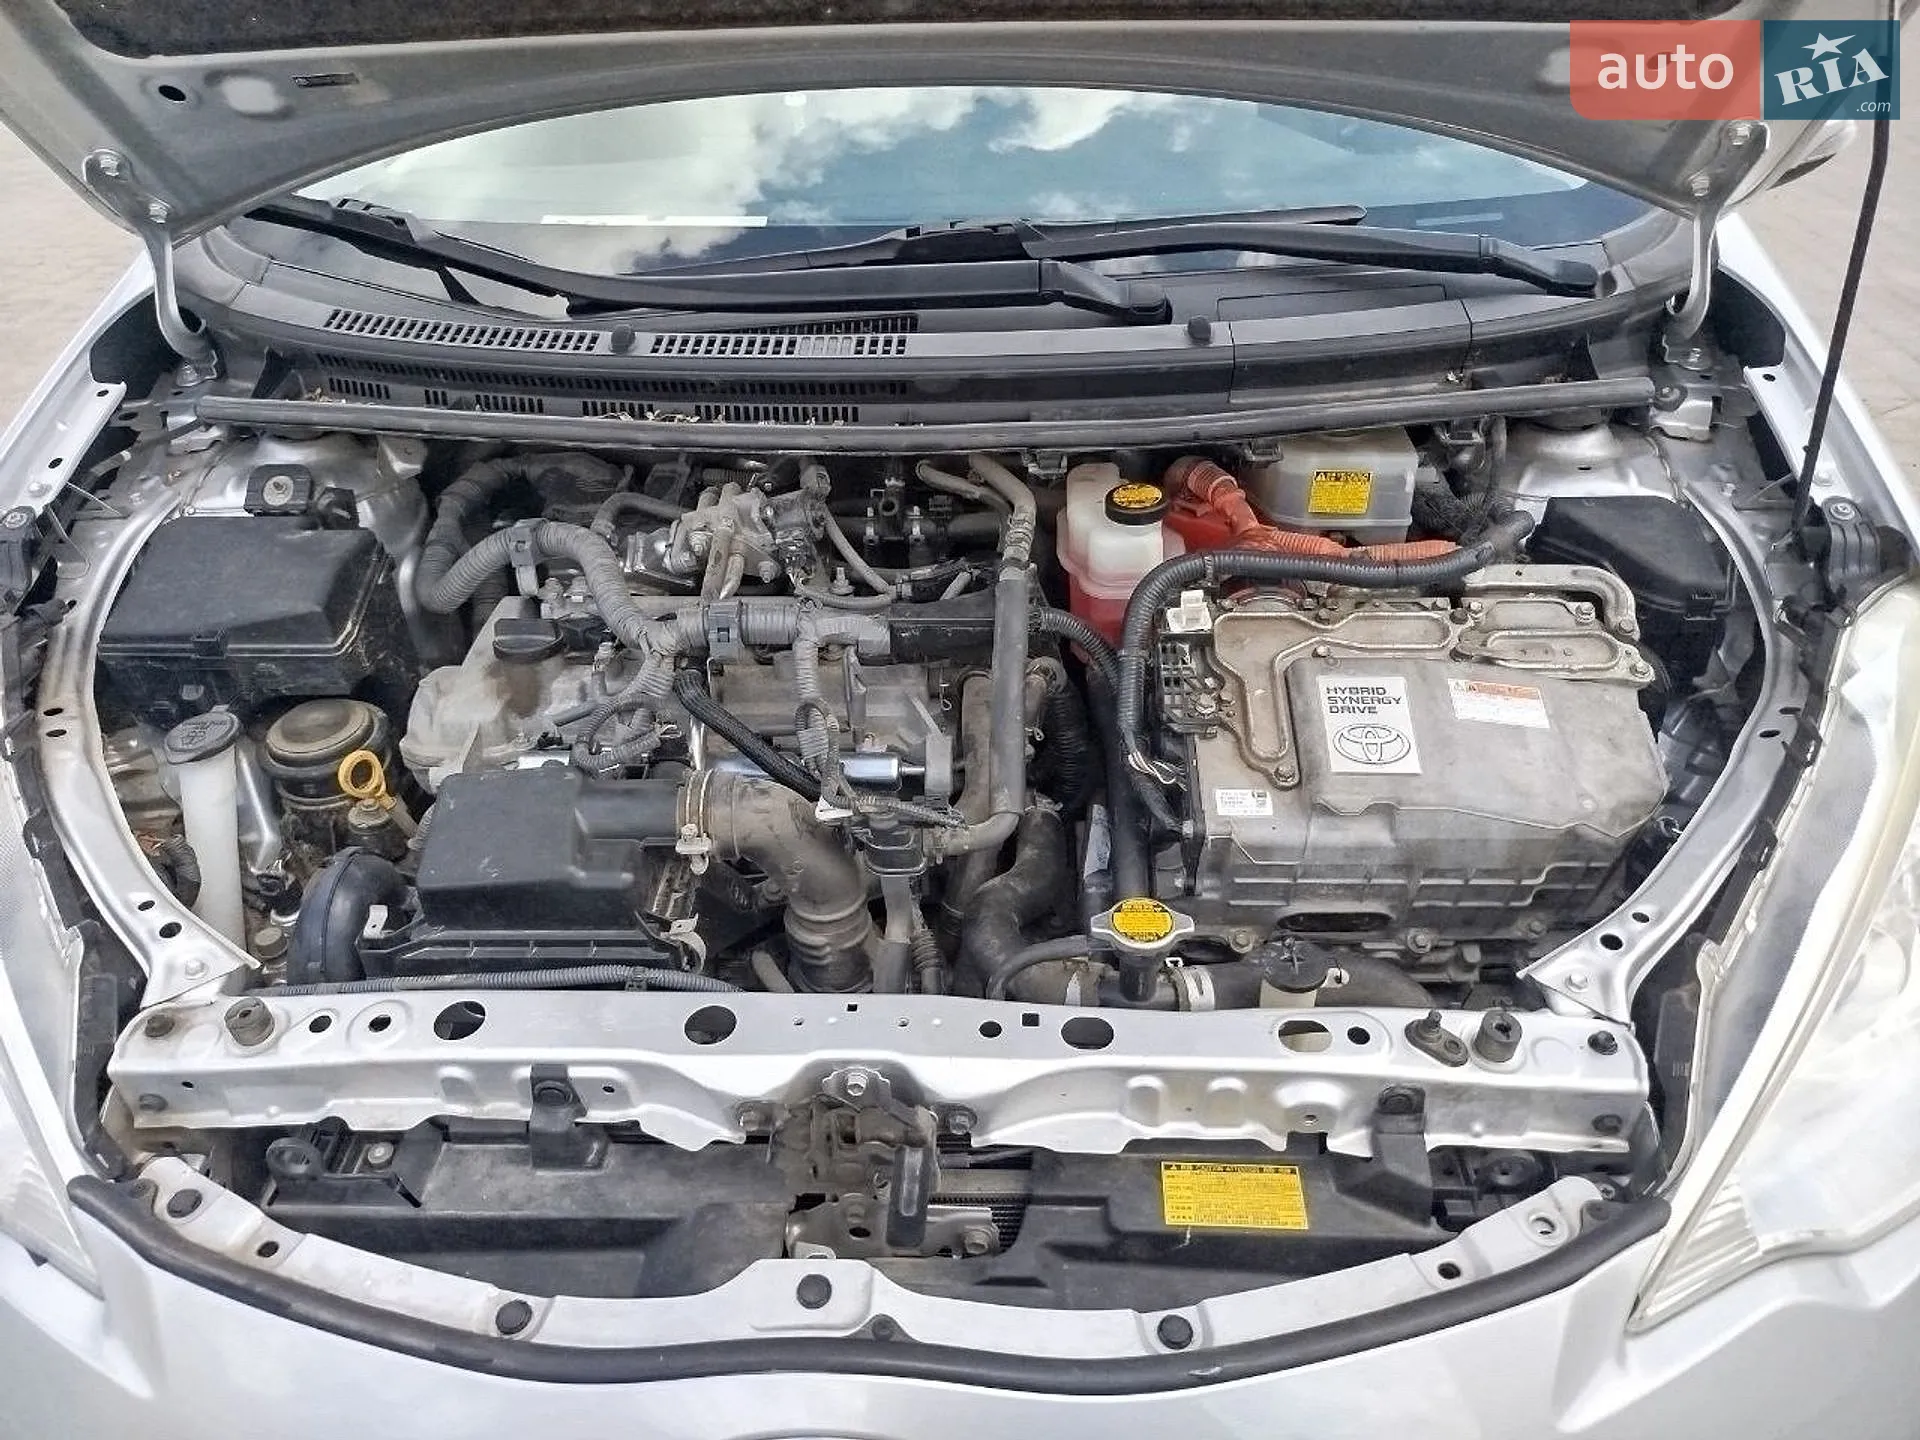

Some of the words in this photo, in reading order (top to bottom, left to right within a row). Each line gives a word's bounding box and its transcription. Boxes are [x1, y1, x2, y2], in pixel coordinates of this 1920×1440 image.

[1326, 686, 1387, 696] HYBRID
[1327, 696, 1402, 705] SYNERGY
[1329, 705, 1378, 714] DRIVE
